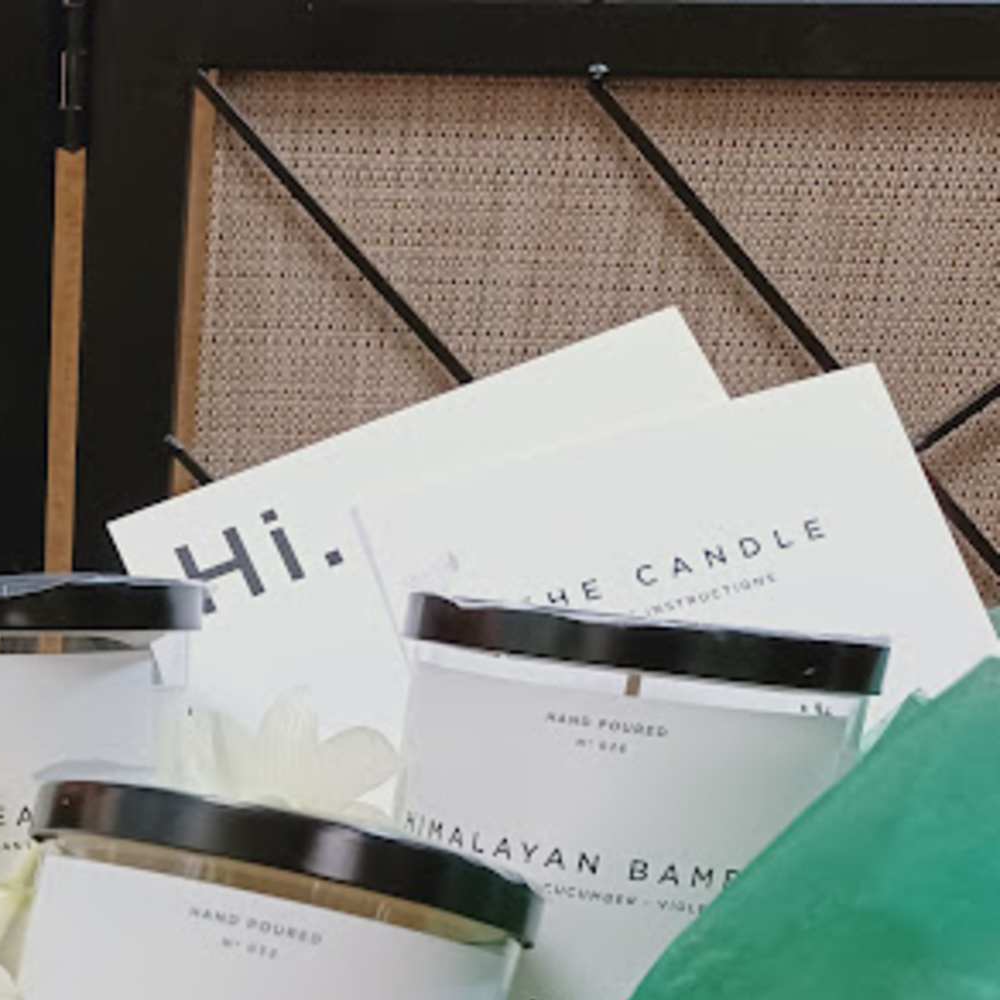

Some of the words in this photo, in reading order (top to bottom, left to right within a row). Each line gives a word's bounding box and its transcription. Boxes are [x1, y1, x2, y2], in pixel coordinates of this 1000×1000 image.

[174, 509, 344, 614] Hi.
[523, 578, 603, 607] HE
[636, 517, 825, 587] CANDLE
[405, 810, 601, 875] HIMALAYAN
